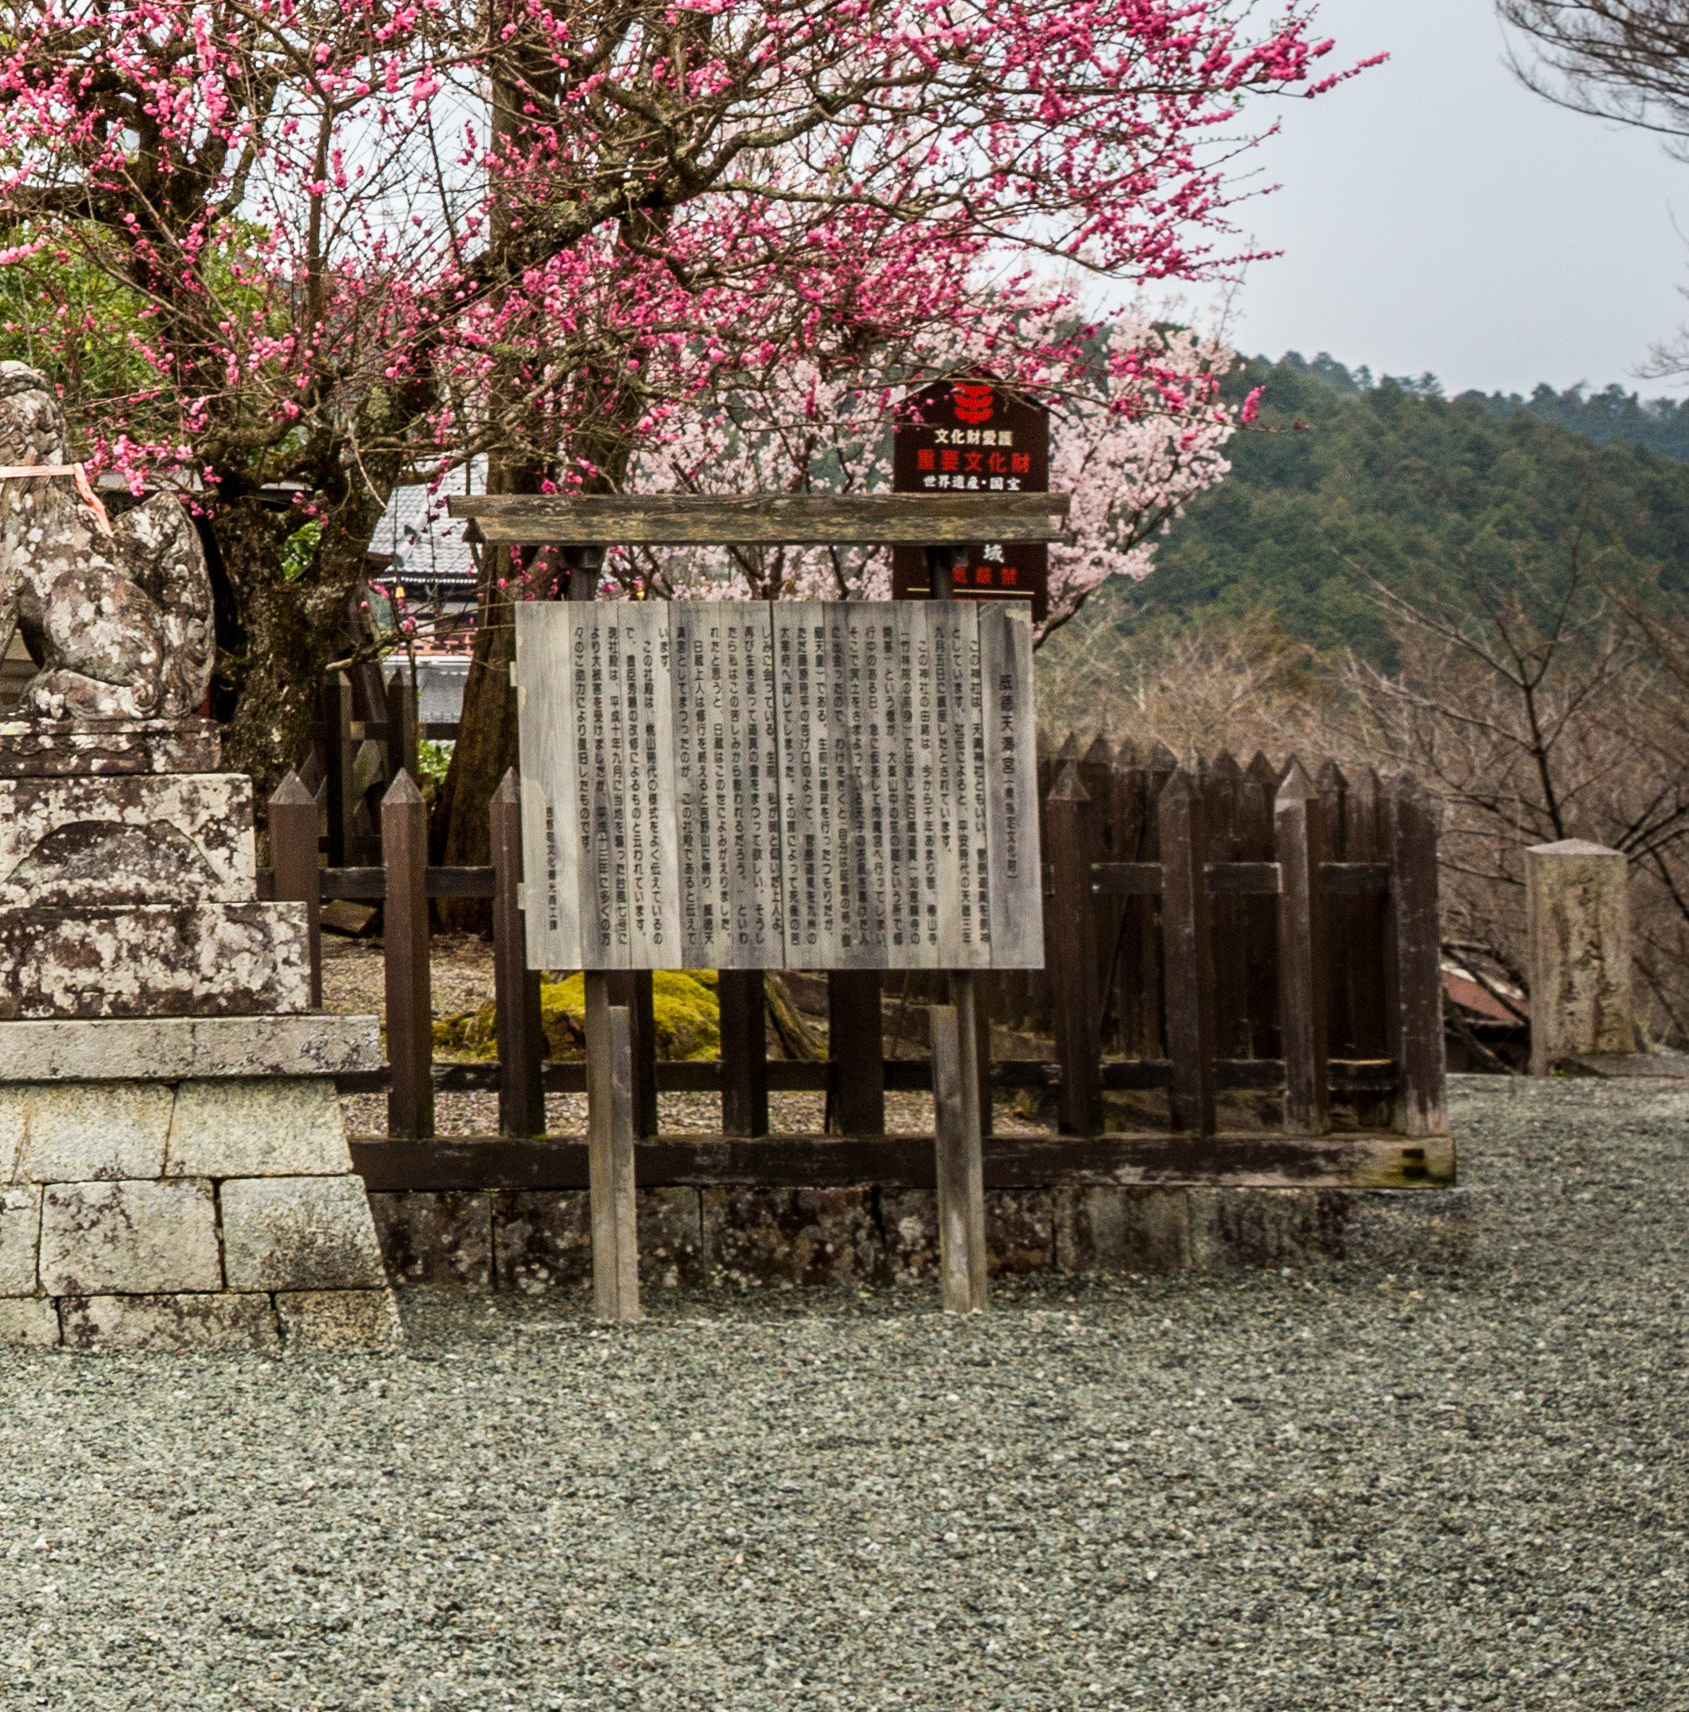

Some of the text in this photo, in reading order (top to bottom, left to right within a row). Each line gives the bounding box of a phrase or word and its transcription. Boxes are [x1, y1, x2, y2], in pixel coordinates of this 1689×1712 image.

[935, 429, 1013, 446] 文化財愛護
[917, 449, 1031, 473] 重要文化財
[658, 626, 671, 672] います。
